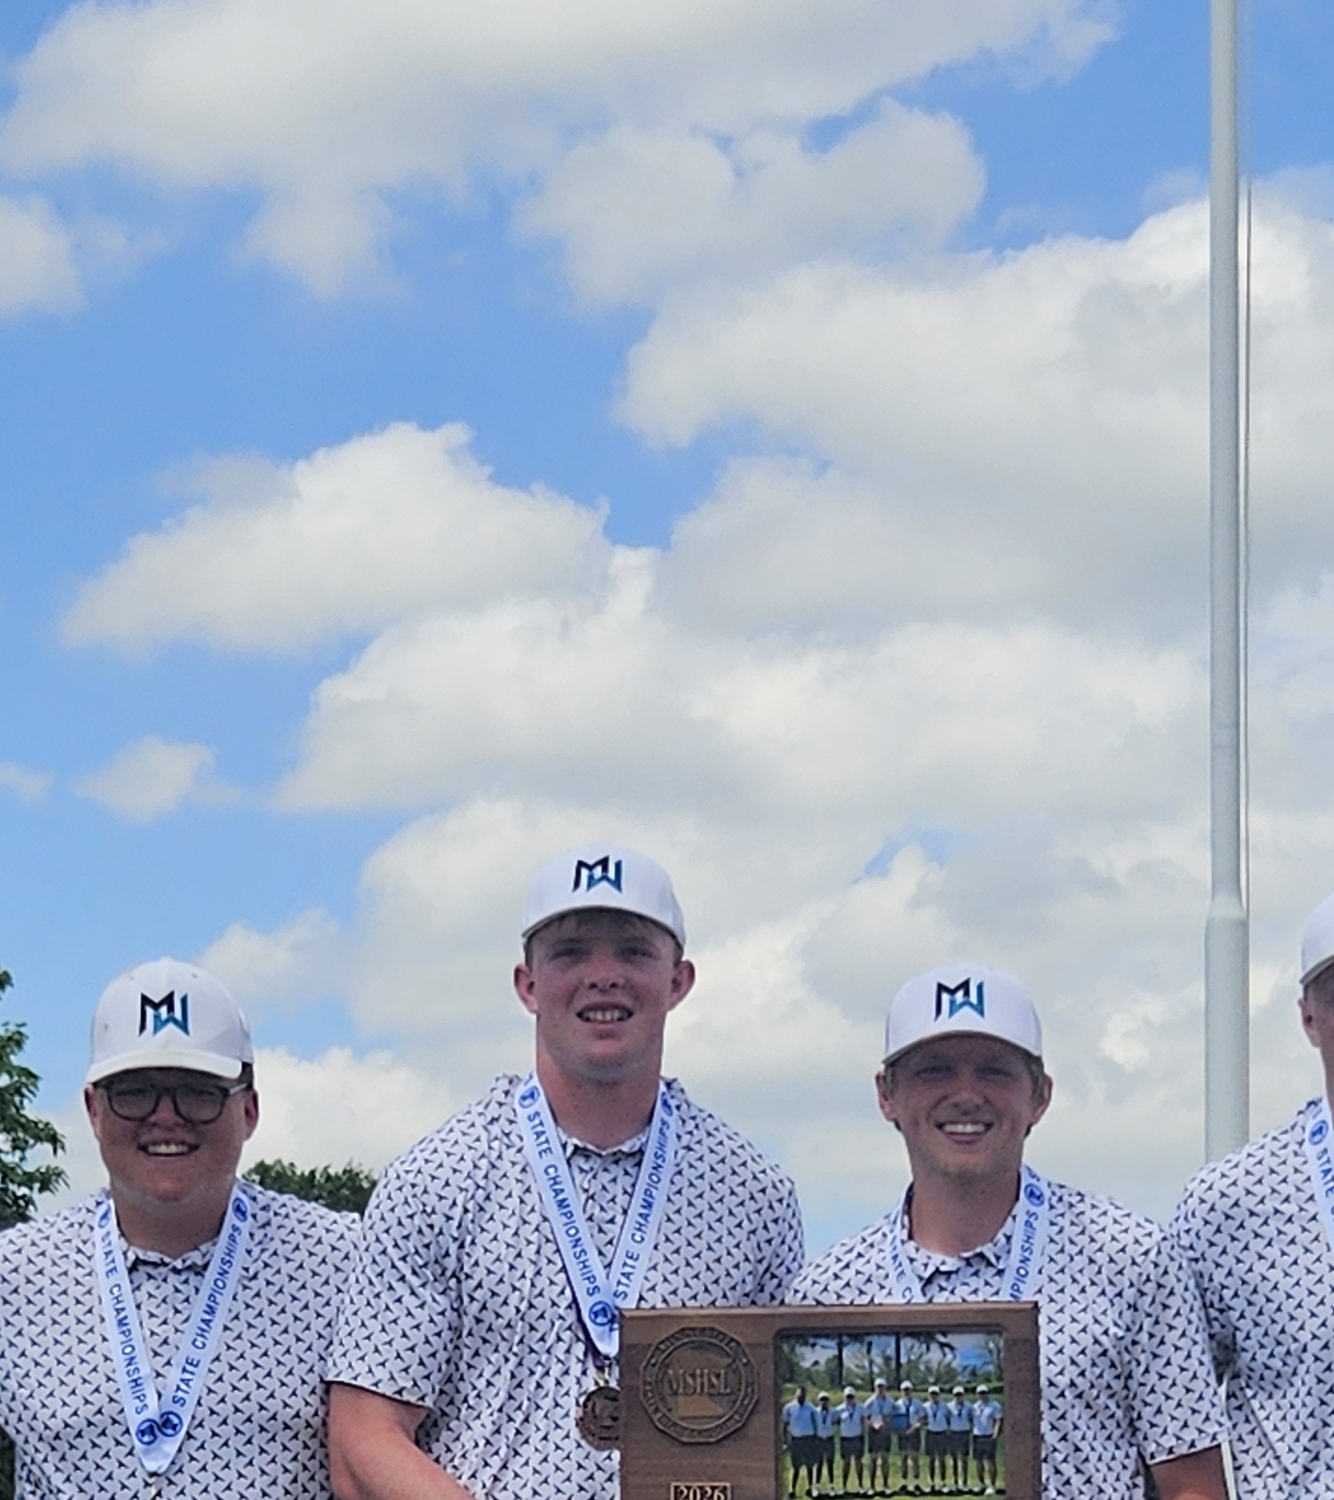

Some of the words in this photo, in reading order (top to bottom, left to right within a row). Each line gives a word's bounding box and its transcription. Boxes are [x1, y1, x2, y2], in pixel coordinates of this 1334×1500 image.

[100, 1231, 118, 1279] STATE
[527, 1111, 554, 1160] STATE
[543, 1164, 600, 1297] CHAMPIONSHIPS
[613, 1251, 640, 1300] STATE
[630, 1119, 671, 1244] CHAMPIONSHIPS
[108, 1283, 149, 1416] CHAMPIONSHIPS
[172, 1357, 201, 1408] STATE
[191, 1224, 242, 1351] CHAMPIONSHIPS
[668, 1368, 731, 1396] MSHSL
